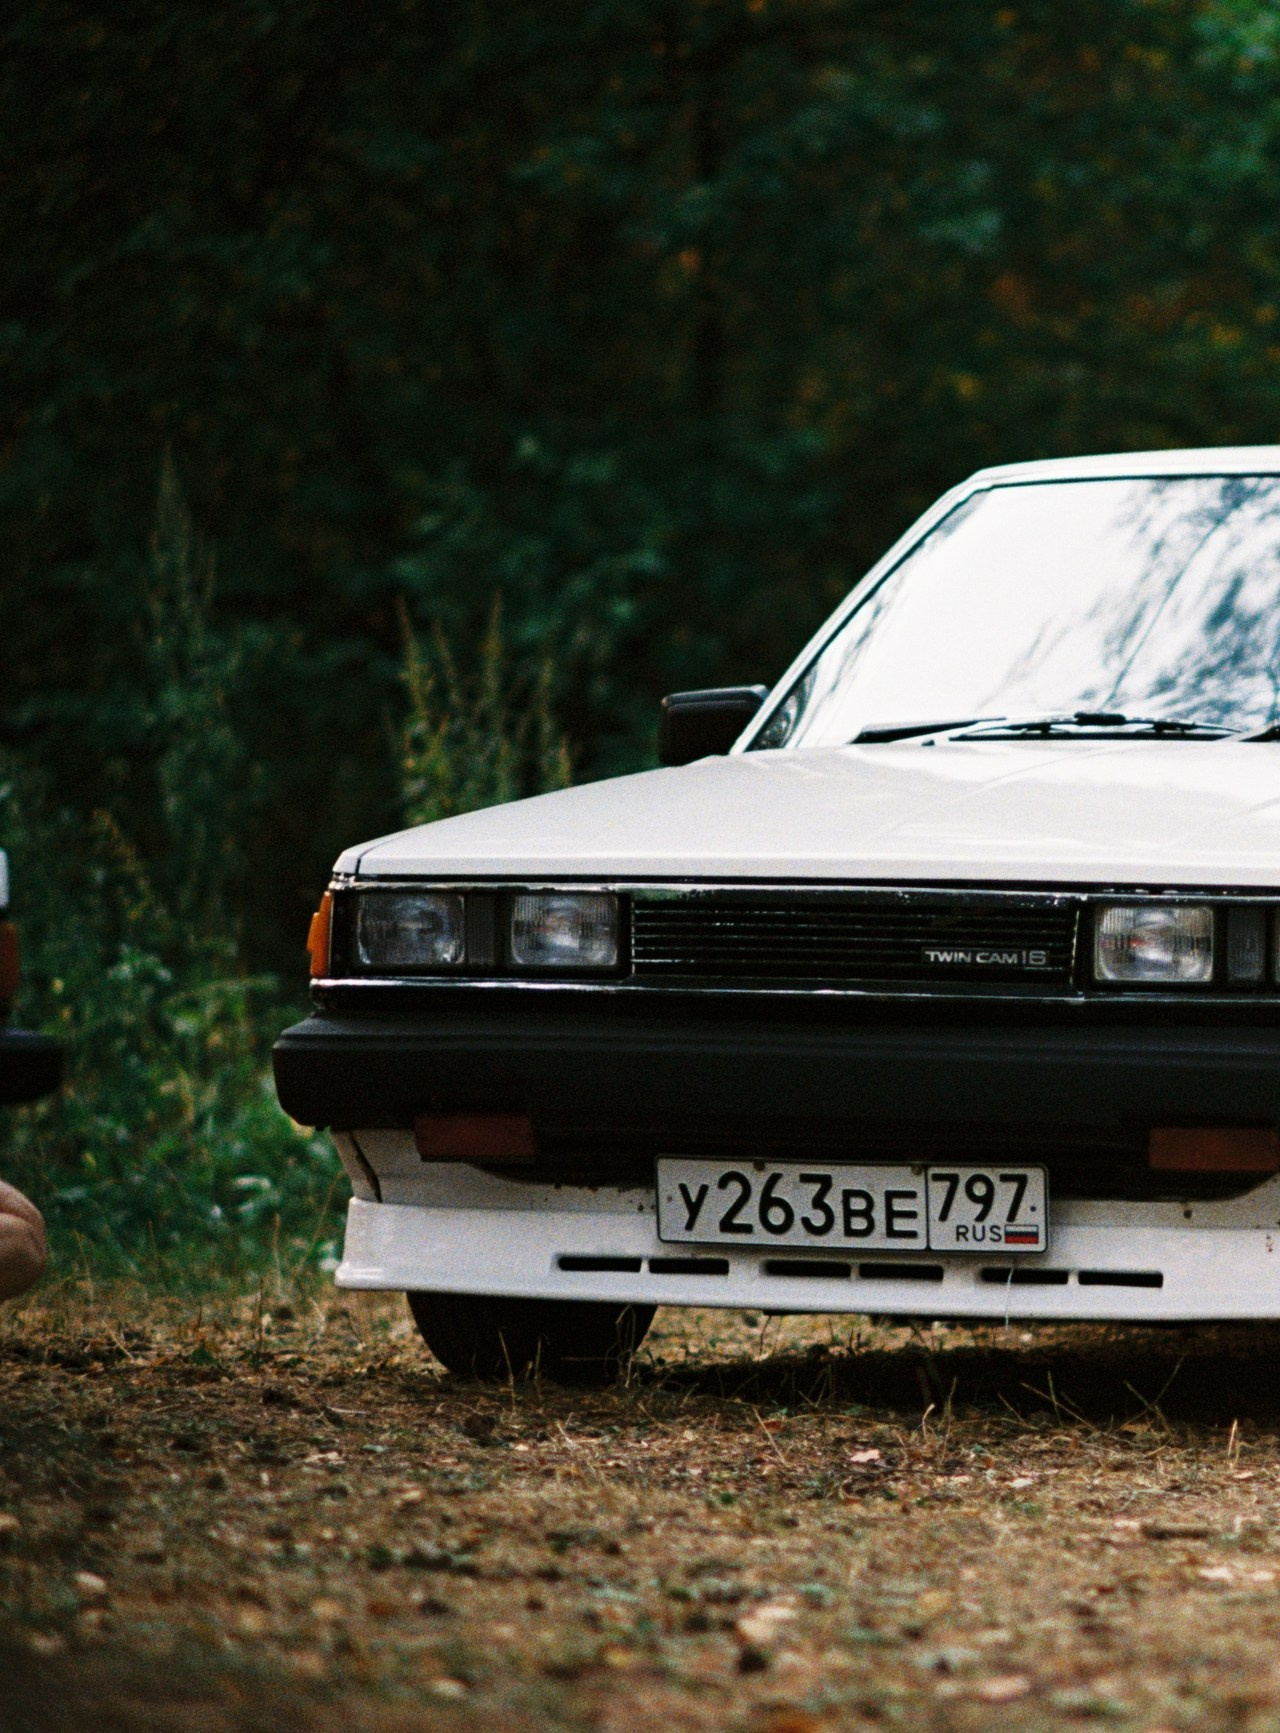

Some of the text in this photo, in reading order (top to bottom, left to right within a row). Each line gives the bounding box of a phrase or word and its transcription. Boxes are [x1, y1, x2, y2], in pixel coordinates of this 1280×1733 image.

[924, 951, 972, 963] TWIN
[931, 1173, 1029, 1223] 797
[955, 1224, 1003, 1243] RUS
